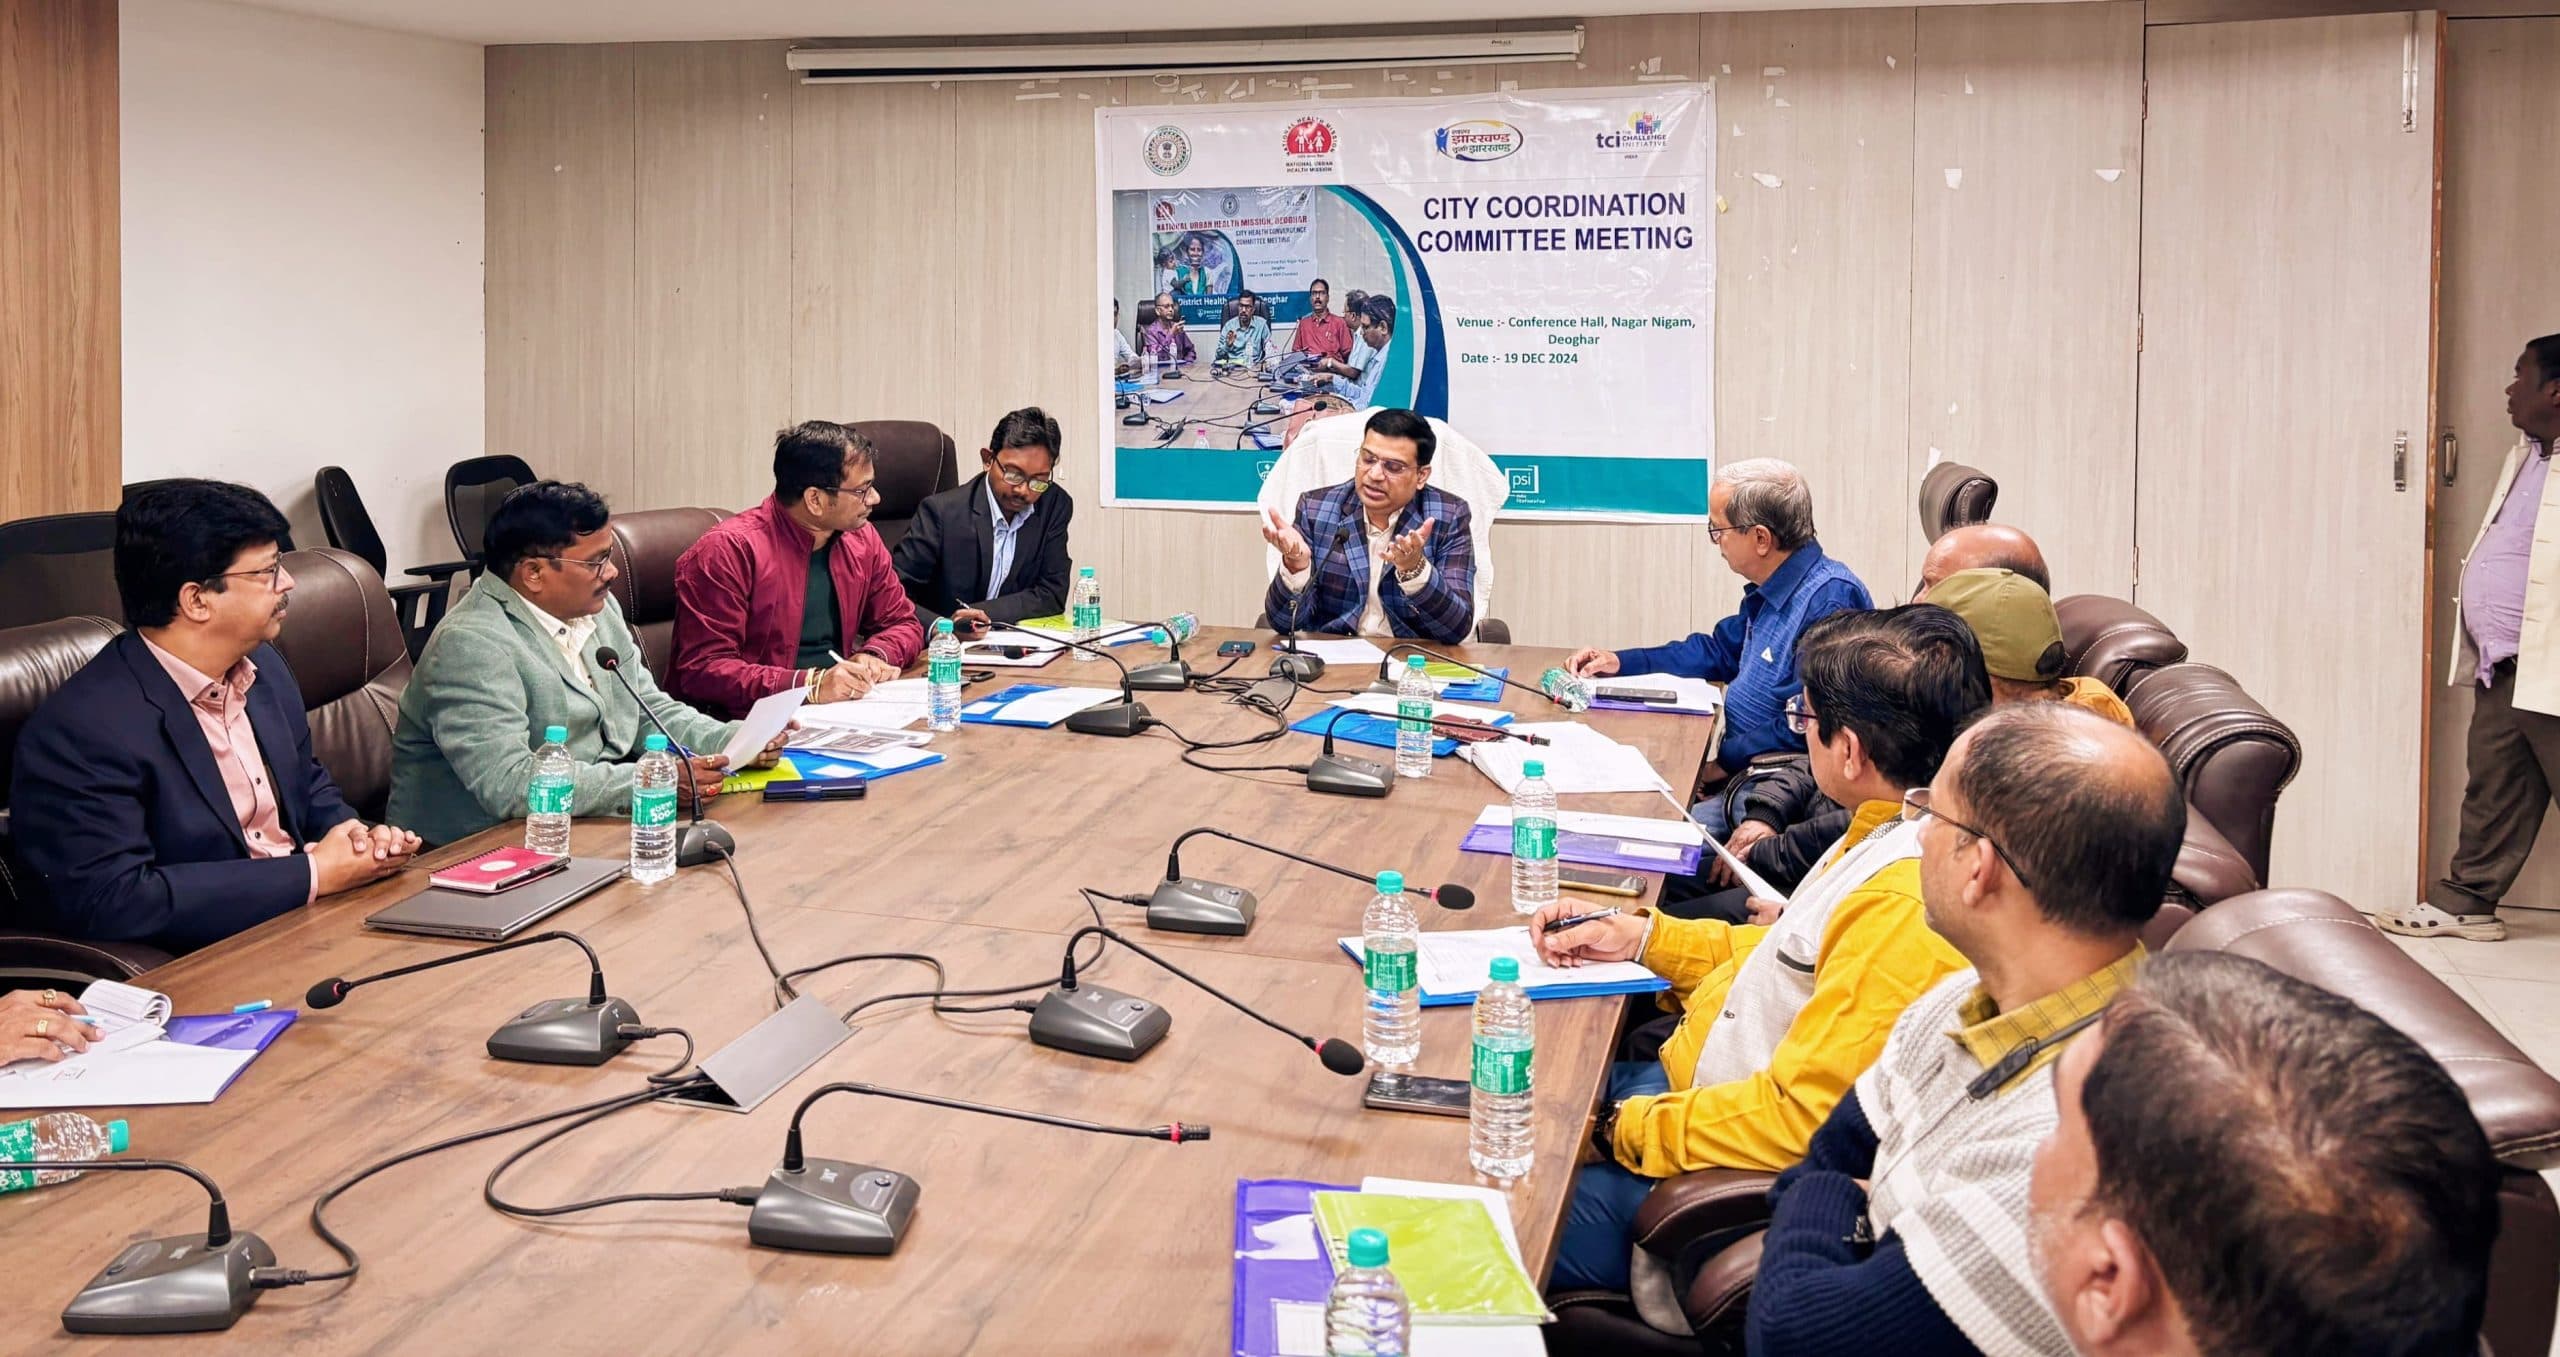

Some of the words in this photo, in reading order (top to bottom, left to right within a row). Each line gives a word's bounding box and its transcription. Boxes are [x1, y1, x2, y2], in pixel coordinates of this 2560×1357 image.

[1596, 131, 1620, 148] tci
[1622, 134, 1667, 142] CHALLENGE
[1423, 197, 1479, 219] CITY
[1486, 192, 1685, 218] COORDINATION
[1417, 229, 1566, 252] COMMITTEE
[1575, 226, 1693, 250] MEETING
[1204, 296, 1227, 305] Health
[1456, 317, 1493, 327] Venue
[1508, 316, 1577, 328] Conference
[1580, 316, 1608, 328] Hall,
[1611, 317, 1648, 329] Nagar
[1651, 316, 1696, 329] Nigam,
[1548, 334, 1600, 347] Deoghar
[1461, 353, 1489, 363] Date
[1504, 353, 1518, 363] 19
[1522, 353, 1545, 363] DEC
[1548, 353, 1578, 363] 2024
[1512, 471, 1531, 489] psi
